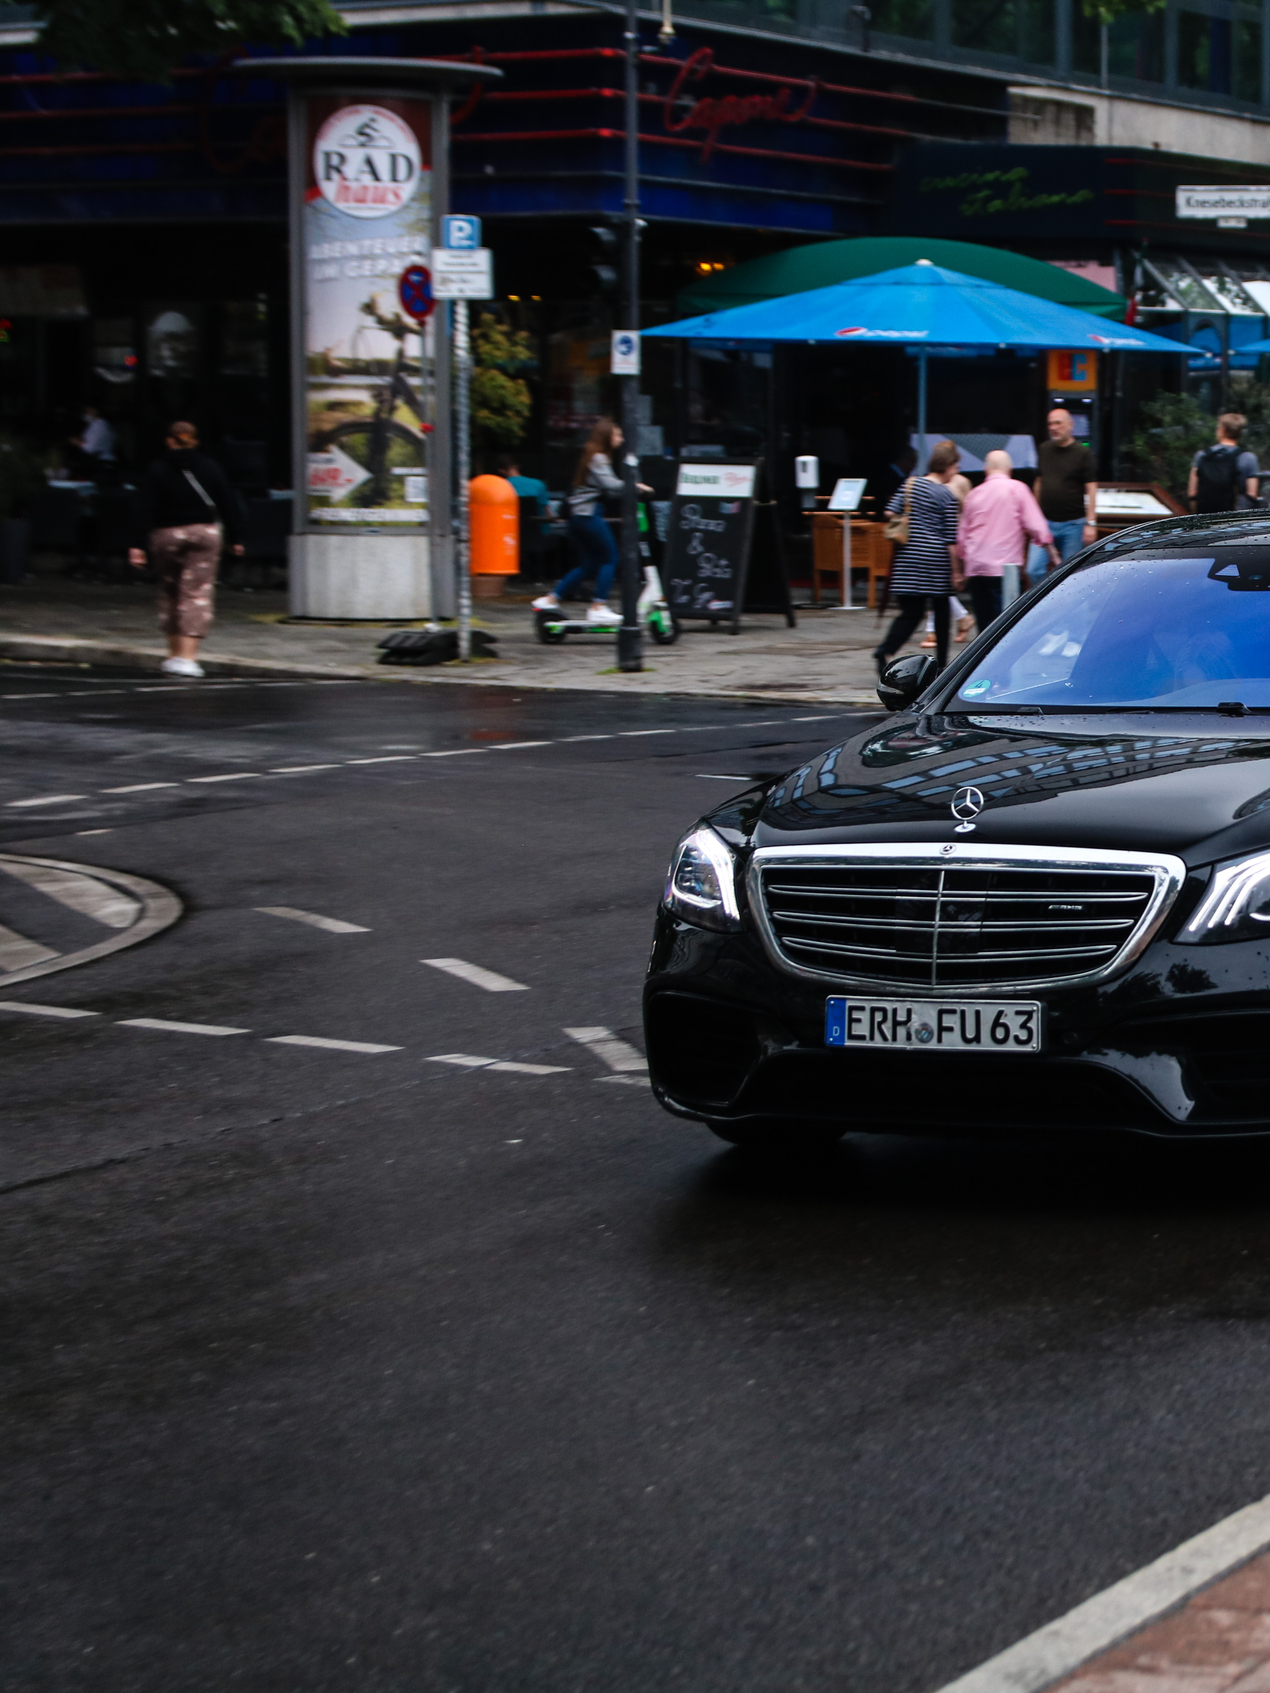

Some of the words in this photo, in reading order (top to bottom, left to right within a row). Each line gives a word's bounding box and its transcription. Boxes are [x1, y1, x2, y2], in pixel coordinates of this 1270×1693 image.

[322, 150, 415, 183] RAD
[334, 176, 406, 205] haus
[832, 1026, 840, 1037] D
[847, 1004, 913, 1042] ERH
[936, 1008, 982, 1044] FU
[990, 1009, 1035, 1045] 63
